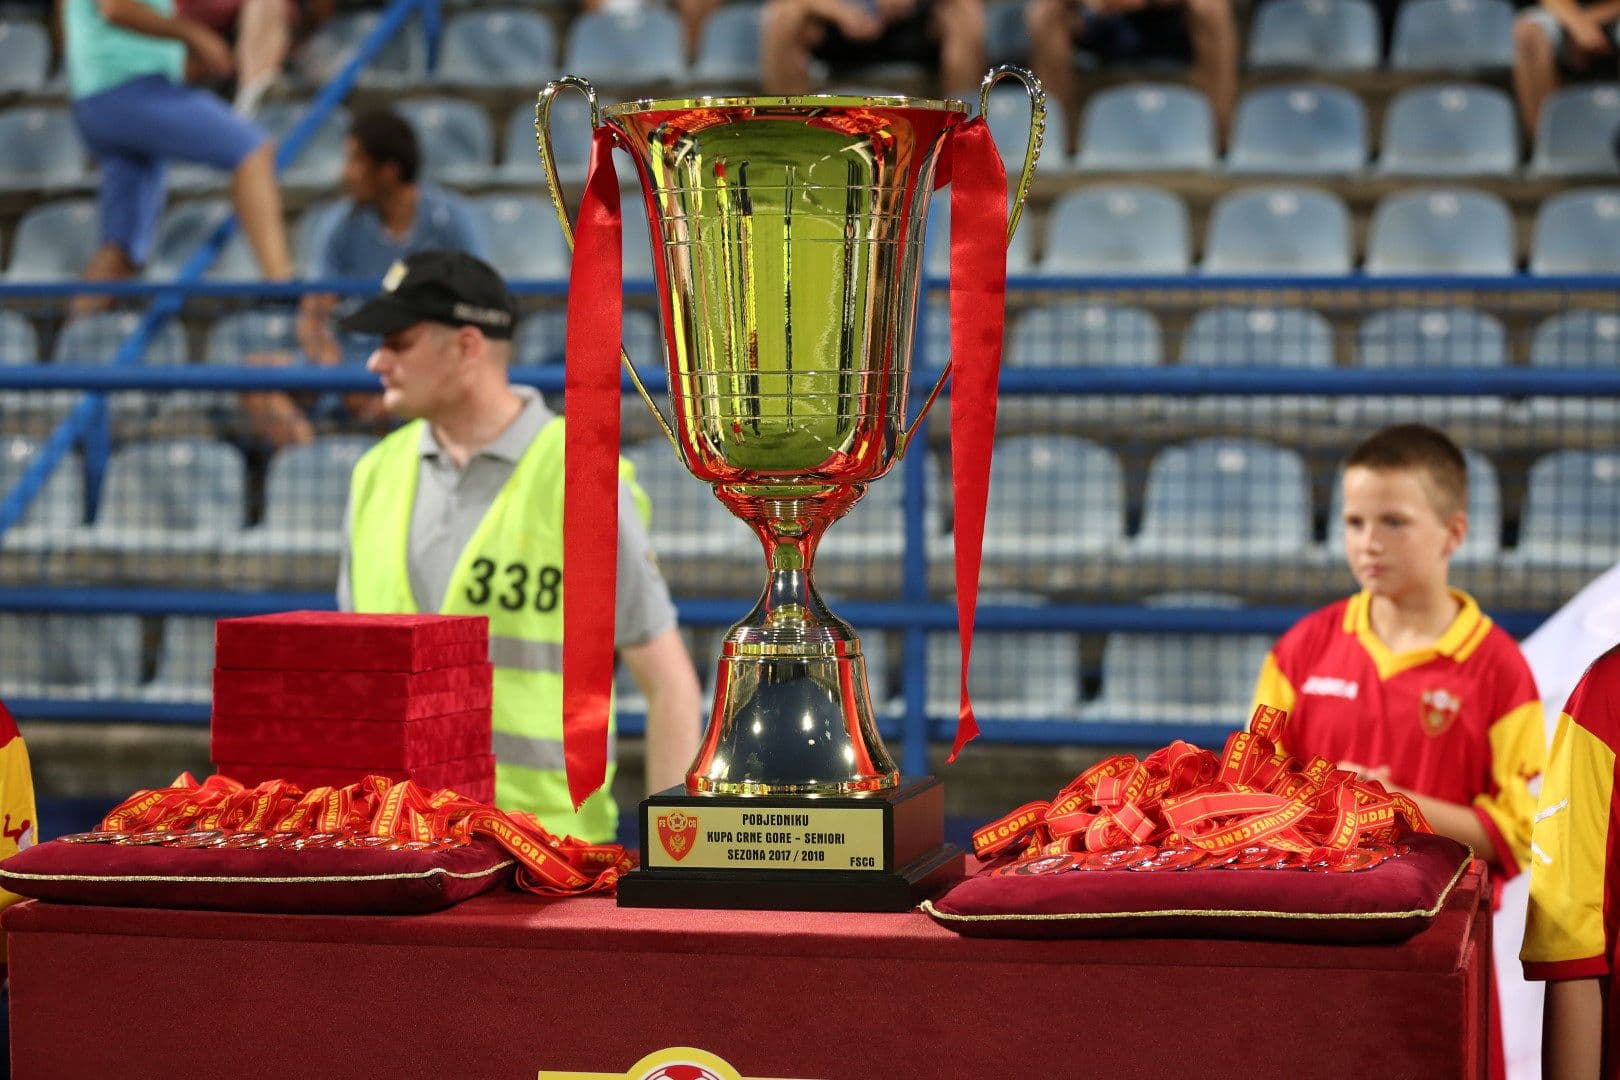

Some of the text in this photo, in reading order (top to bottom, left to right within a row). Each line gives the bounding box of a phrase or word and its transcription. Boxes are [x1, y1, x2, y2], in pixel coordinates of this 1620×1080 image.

[466, 558, 562, 613] 338
[1228, 733, 1250, 769] GORE
[742, 813, 809, 826] POBJEDNIKU
[998, 812, 1036, 837] GORE
[707, 831, 733, 843] KUPA
[736, 831, 762, 843] CRNE
[765, 832, 792, 844] GORE
[804, 832, 845, 844] SENIORI
[511, 836, 547, 865] GORE
[727, 849, 766, 861] SEZONA
[768, 850, 791, 861] 2017
[801, 850, 825, 862] 2018
[850, 856, 875, 867] FSCG
